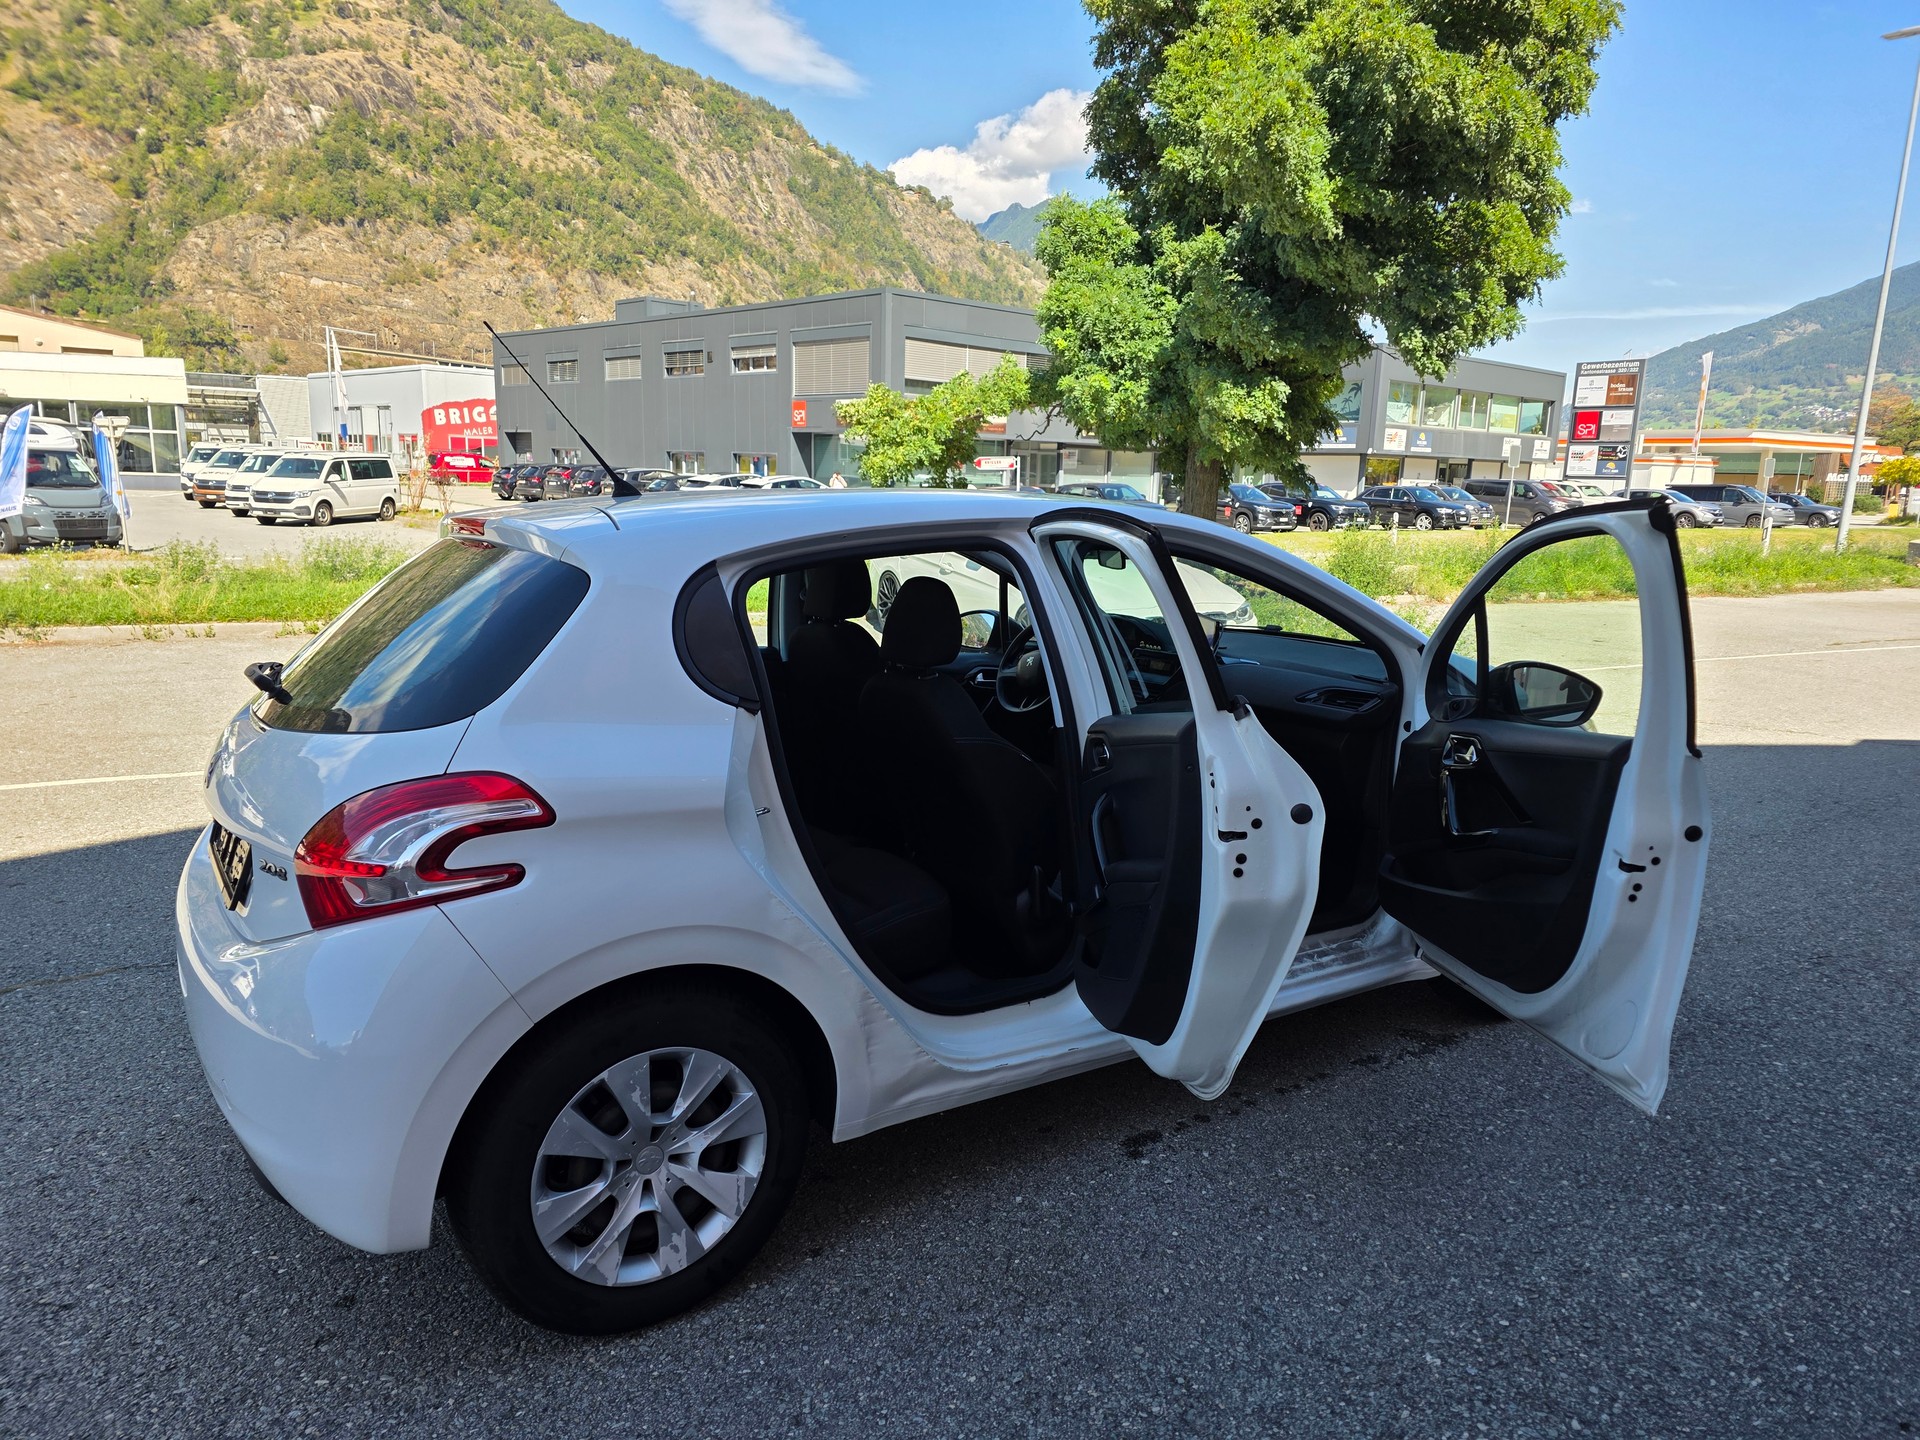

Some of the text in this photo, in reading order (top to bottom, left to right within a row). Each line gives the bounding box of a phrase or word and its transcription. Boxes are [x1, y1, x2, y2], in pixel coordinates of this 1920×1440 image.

[1581, 361, 1640, 369] Gewerbezentrum
[793, 409, 805, 421] SPI
[463, 426, 493, 436] MALER
[1577, 423, 1596, 435] SPI
[258, 858, 288, 881] 208
